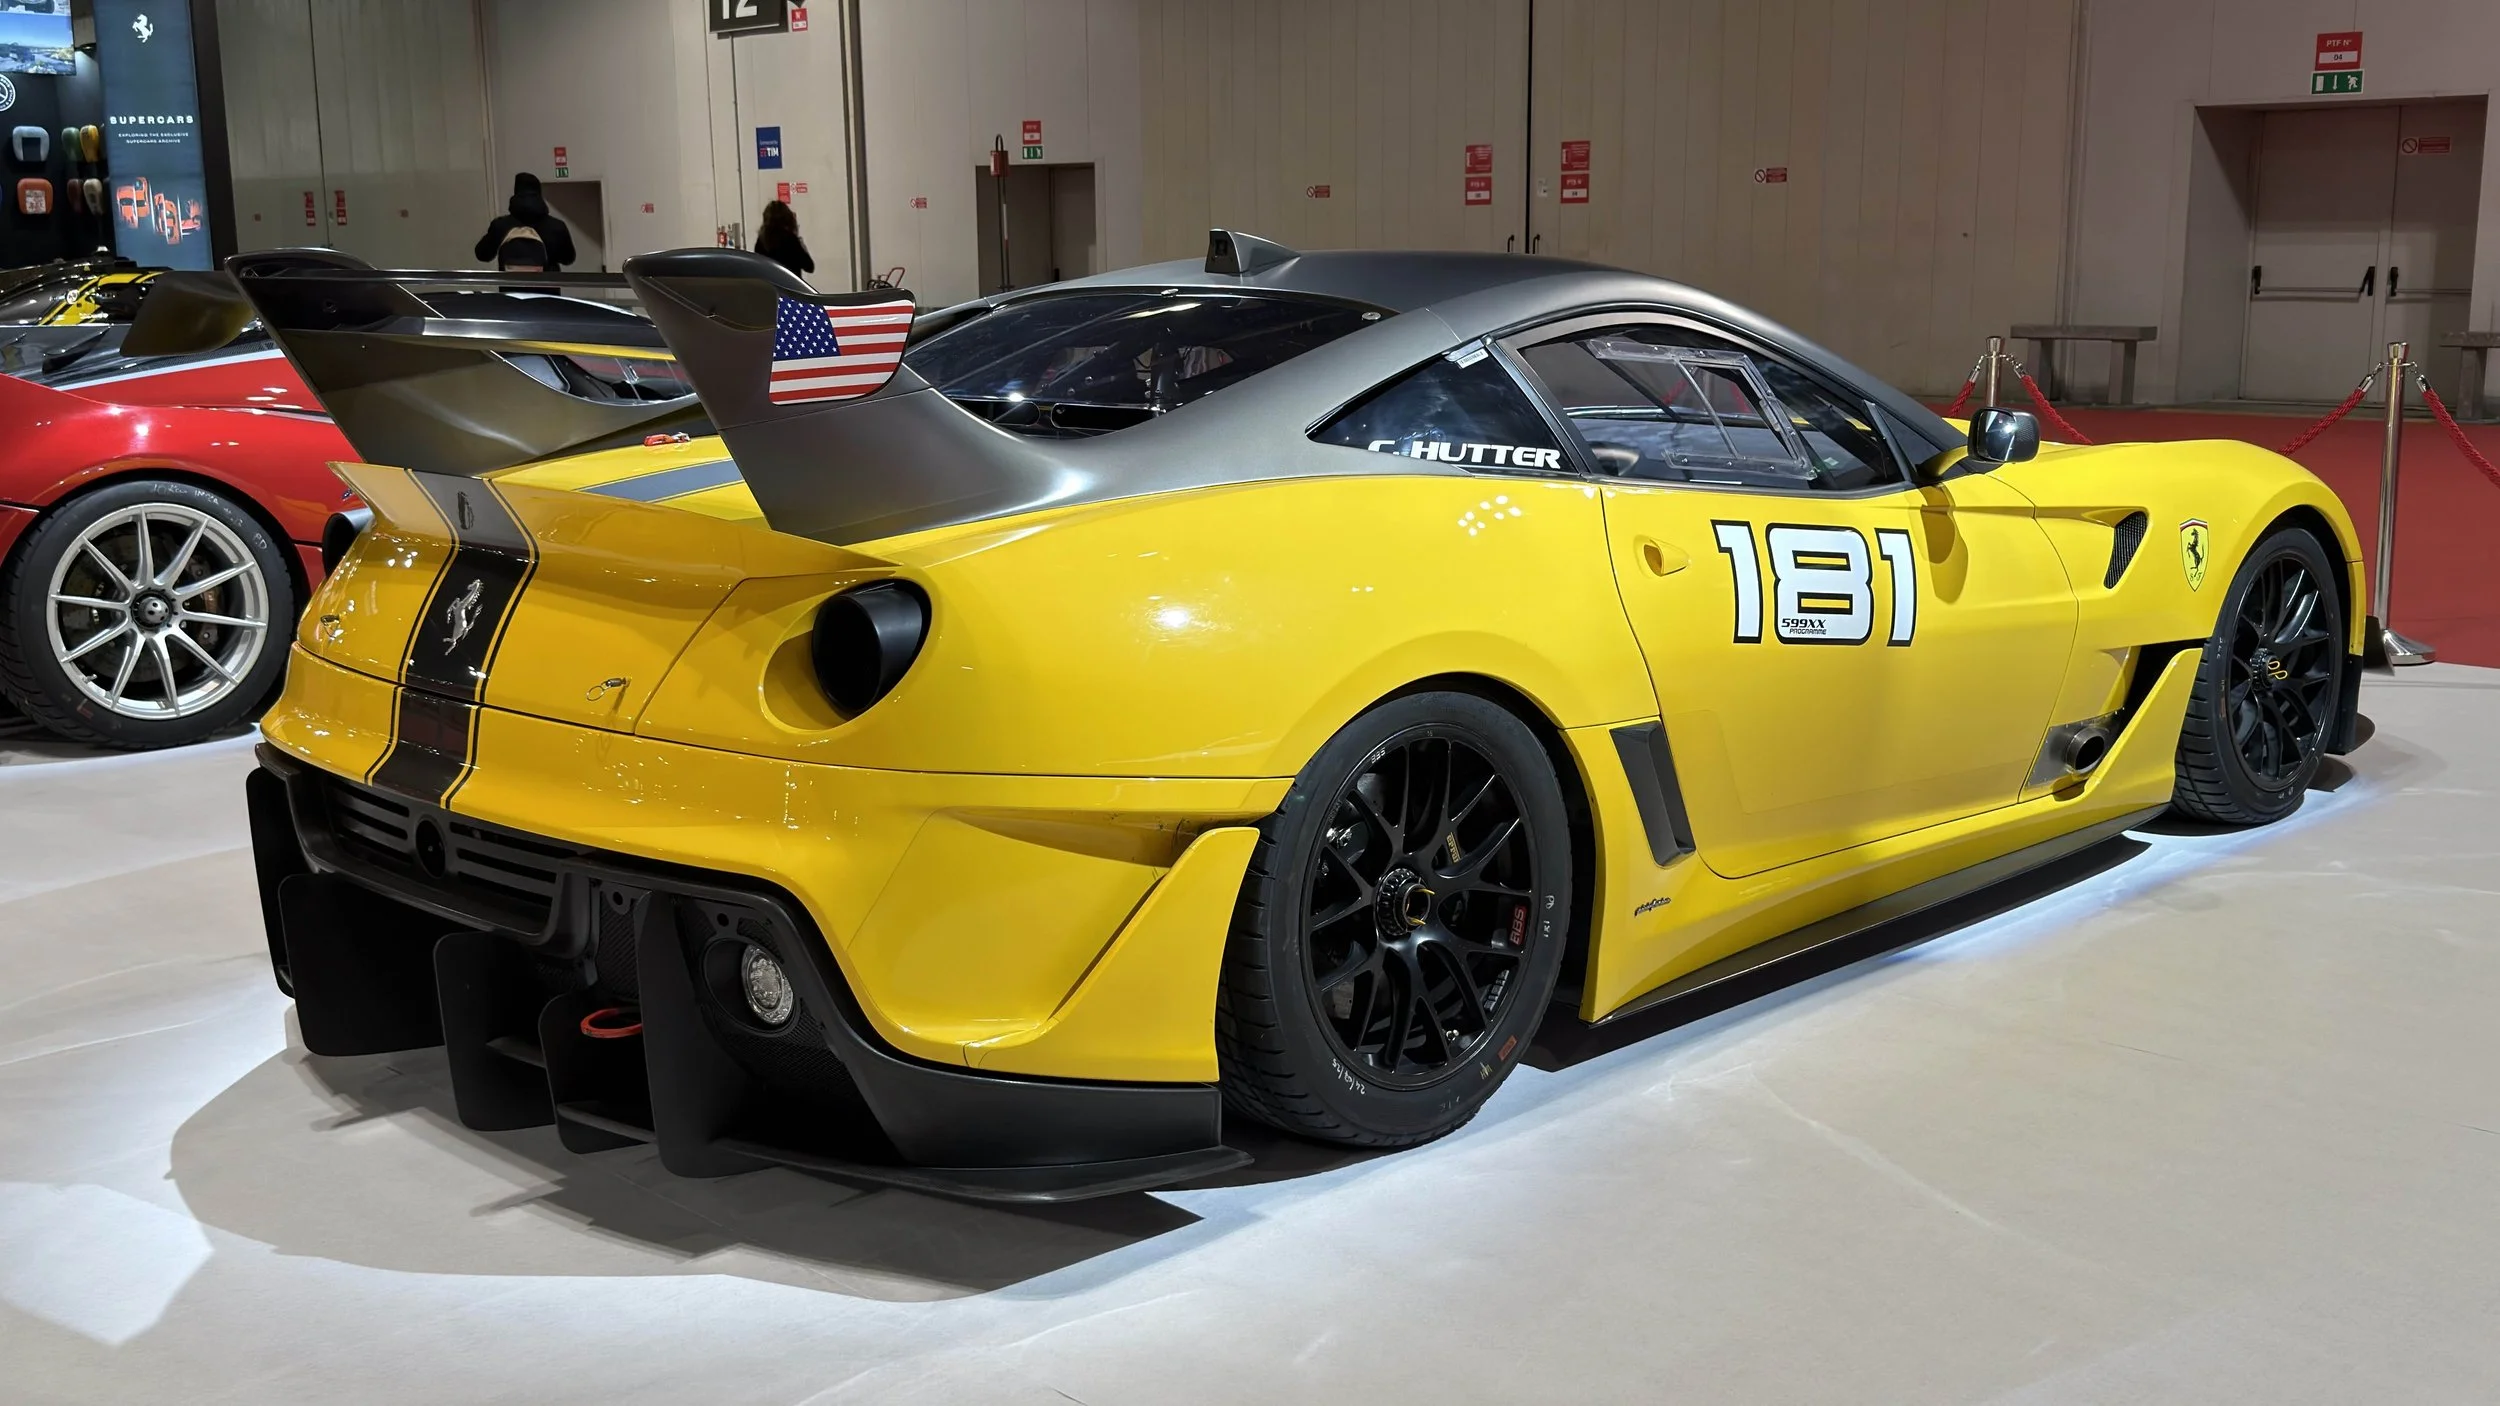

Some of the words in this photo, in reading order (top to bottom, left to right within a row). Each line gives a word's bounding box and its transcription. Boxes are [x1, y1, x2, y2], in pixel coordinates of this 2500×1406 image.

[2326, 39, 2341, 47] PTF
[109, 115, 194, 124] SUPERCARS
[766, 147, 779, 157] TIM
[1410, 440, 1561, 469] HUTTER
[1710, 519, 1918, 647] 181
[1781, 618, 1827, 629] 599XX
[1789, 628, 1827, 636] PROGRAMME
